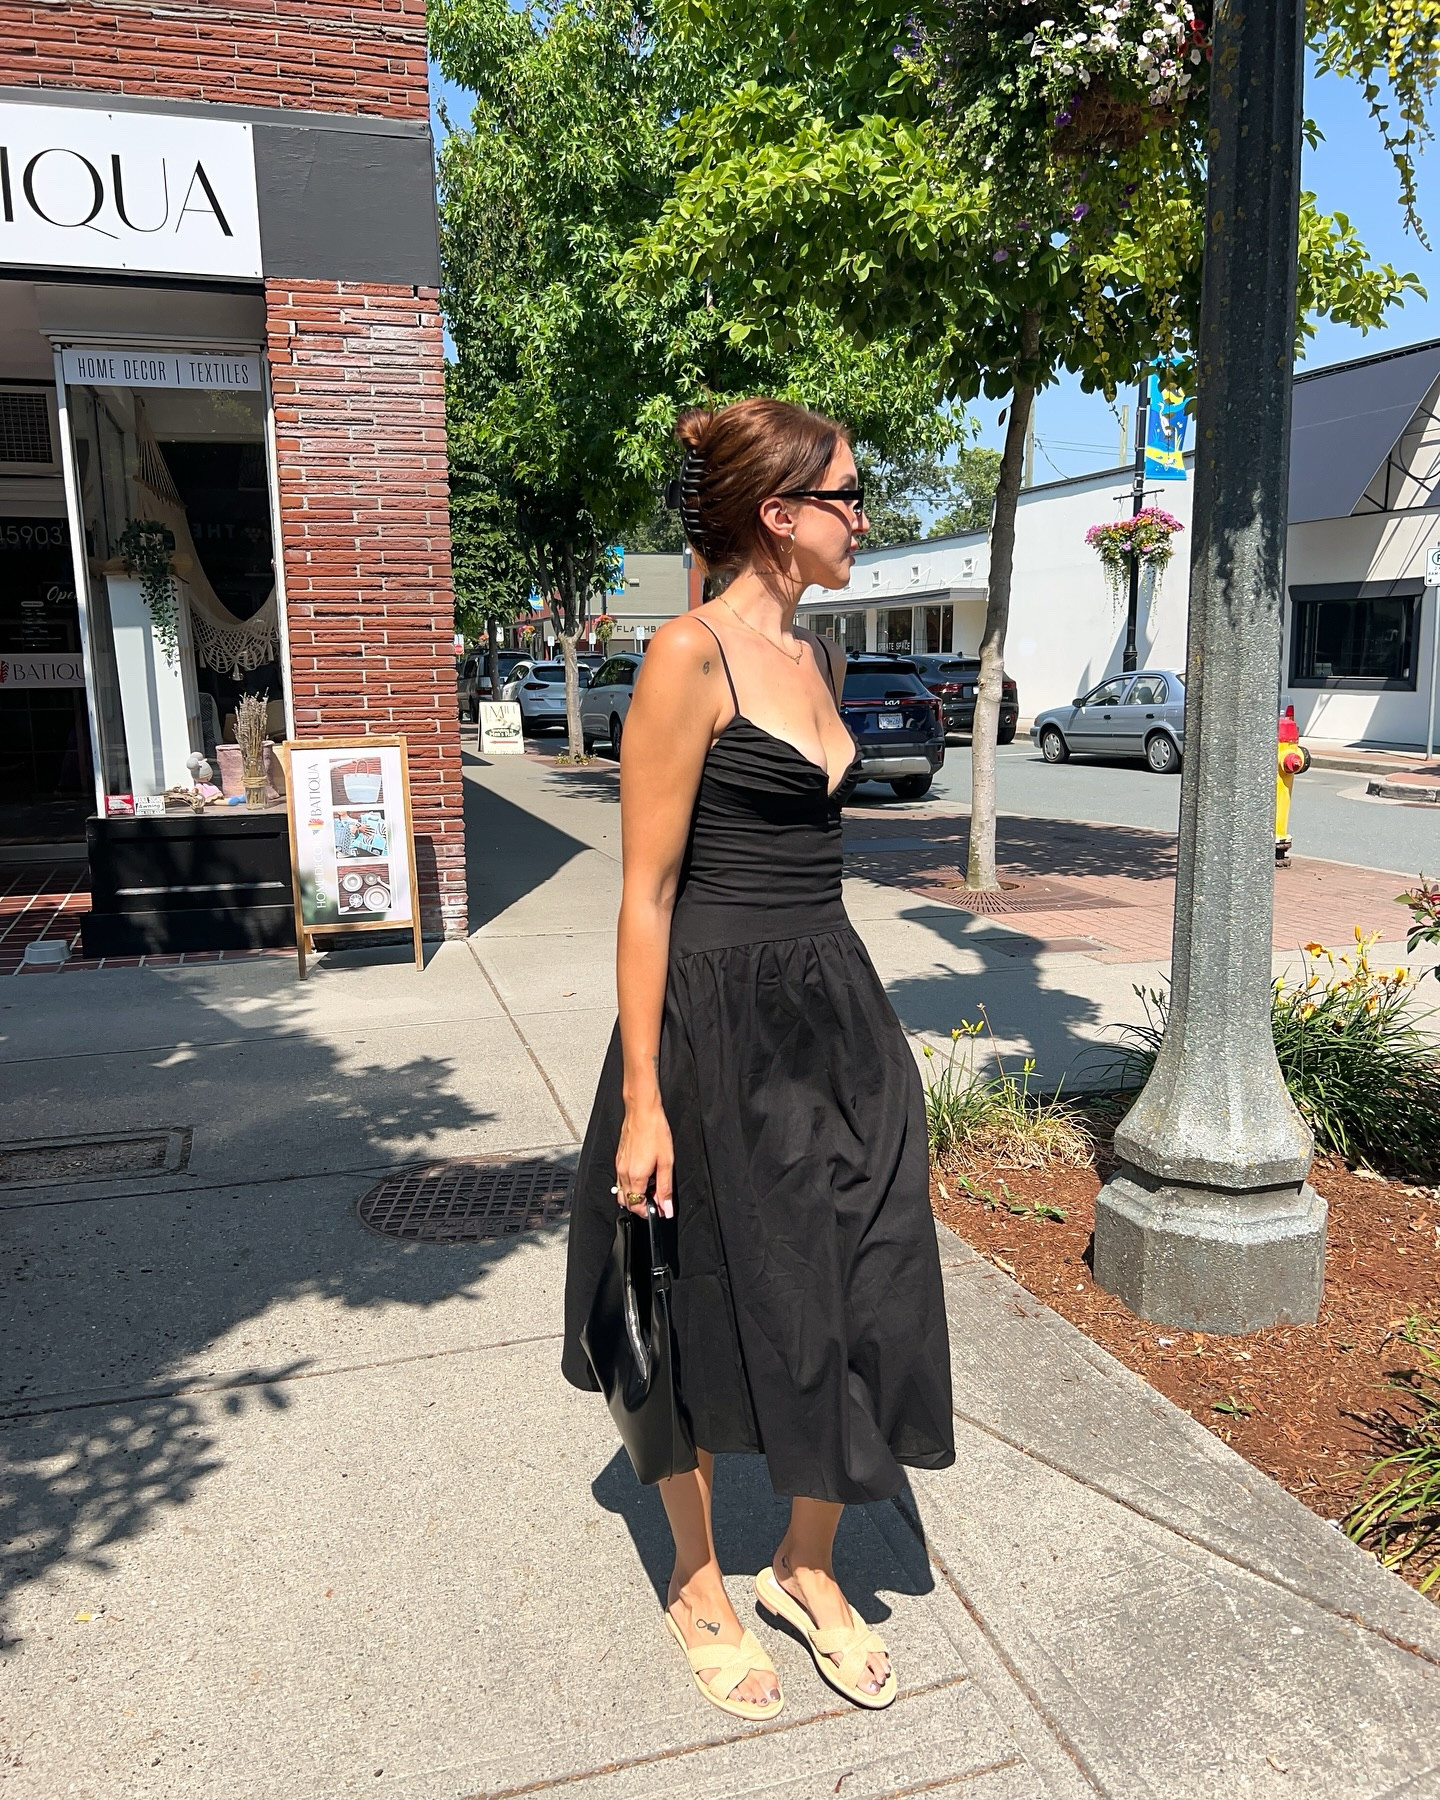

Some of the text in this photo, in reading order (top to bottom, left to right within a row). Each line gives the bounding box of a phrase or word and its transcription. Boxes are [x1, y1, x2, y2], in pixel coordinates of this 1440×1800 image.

[0, 146, 233, 240] IQUA
[77, 357, 116, 379] HOME
[123, 359, 167, 381] DECOR
[189, 362, 249, 384] TEXTILES
[0, 525, 63, 545] 5903
[616, 625, 661, 633] FLAHB
[308, 763, 322, 816] BATIQUA
